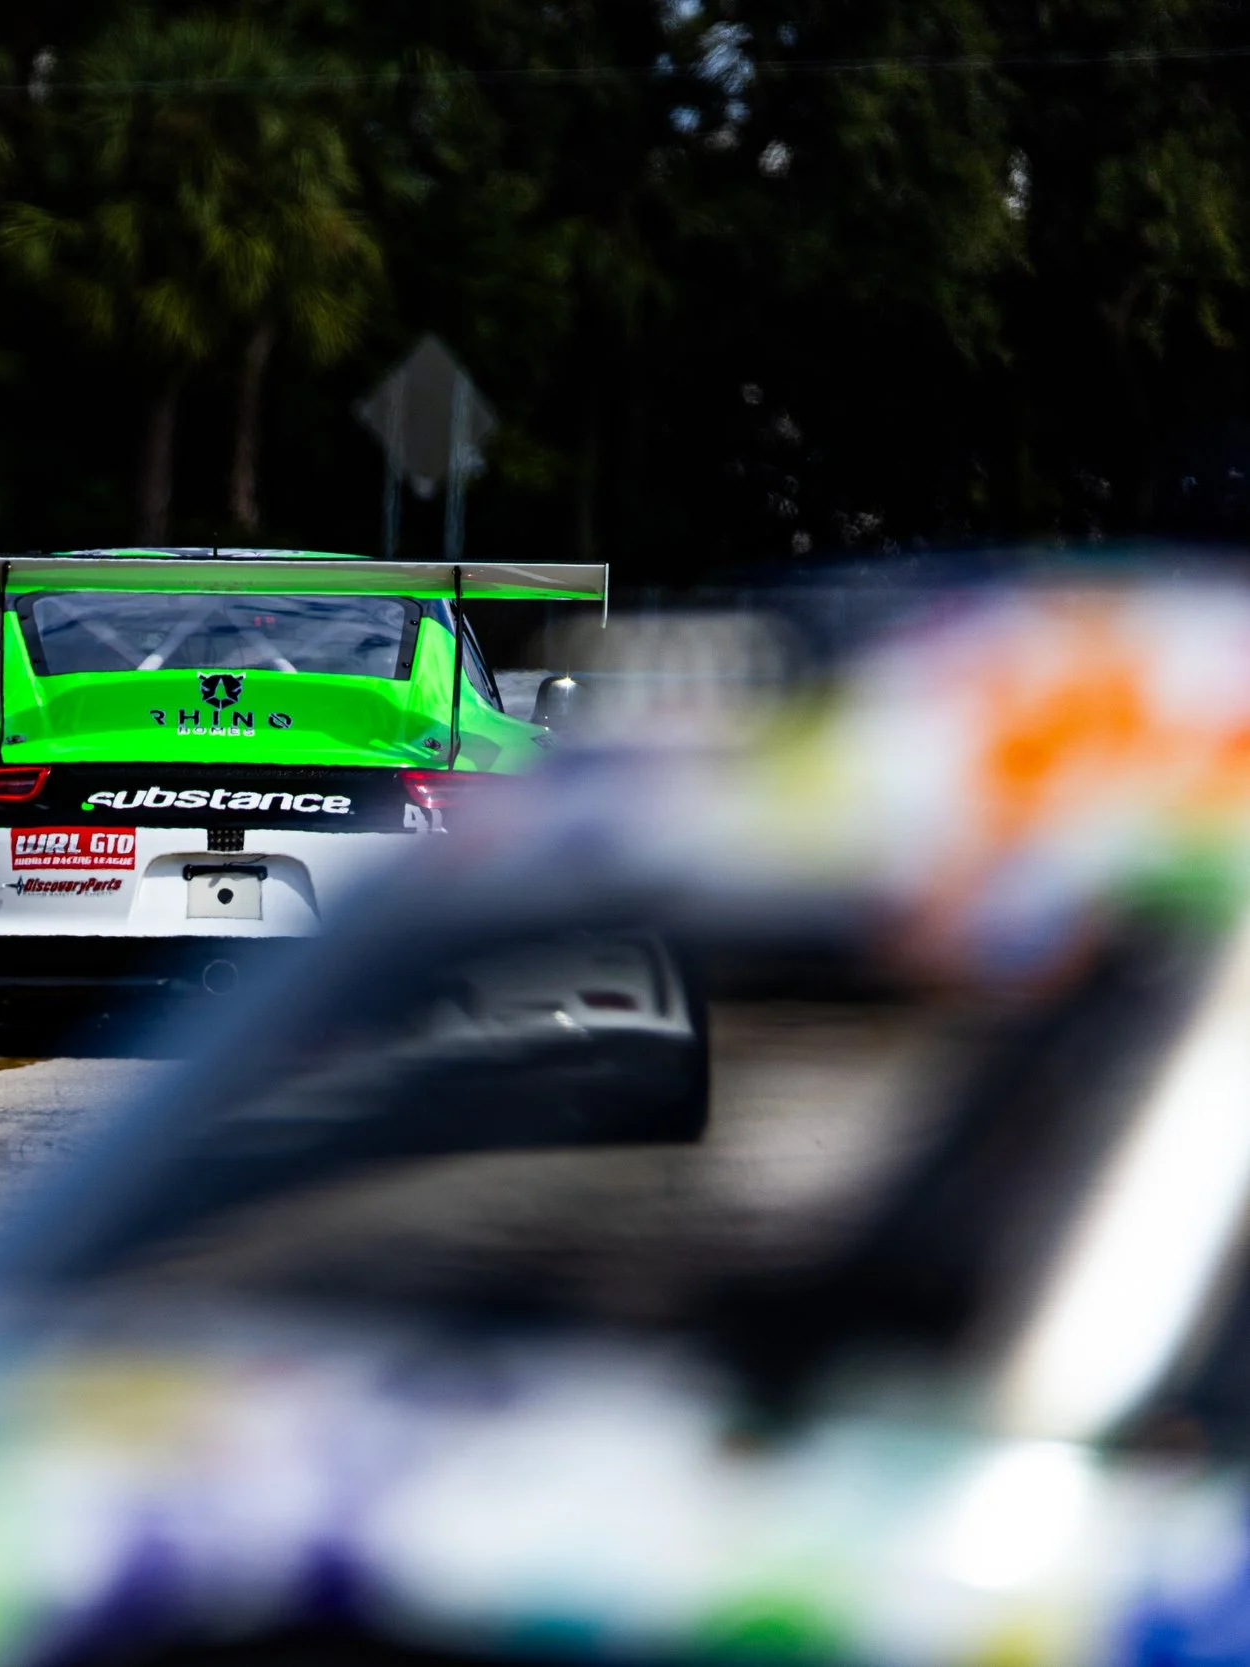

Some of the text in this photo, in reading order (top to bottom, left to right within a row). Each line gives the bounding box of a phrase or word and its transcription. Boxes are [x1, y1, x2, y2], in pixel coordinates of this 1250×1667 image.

[150, 708, 293, 729] RHINO
[82, 785, 352, 815] substance
[15, 833, 81, 855] WRL
[14, 855, 135, 867] WORLD RACING LEAGUE
